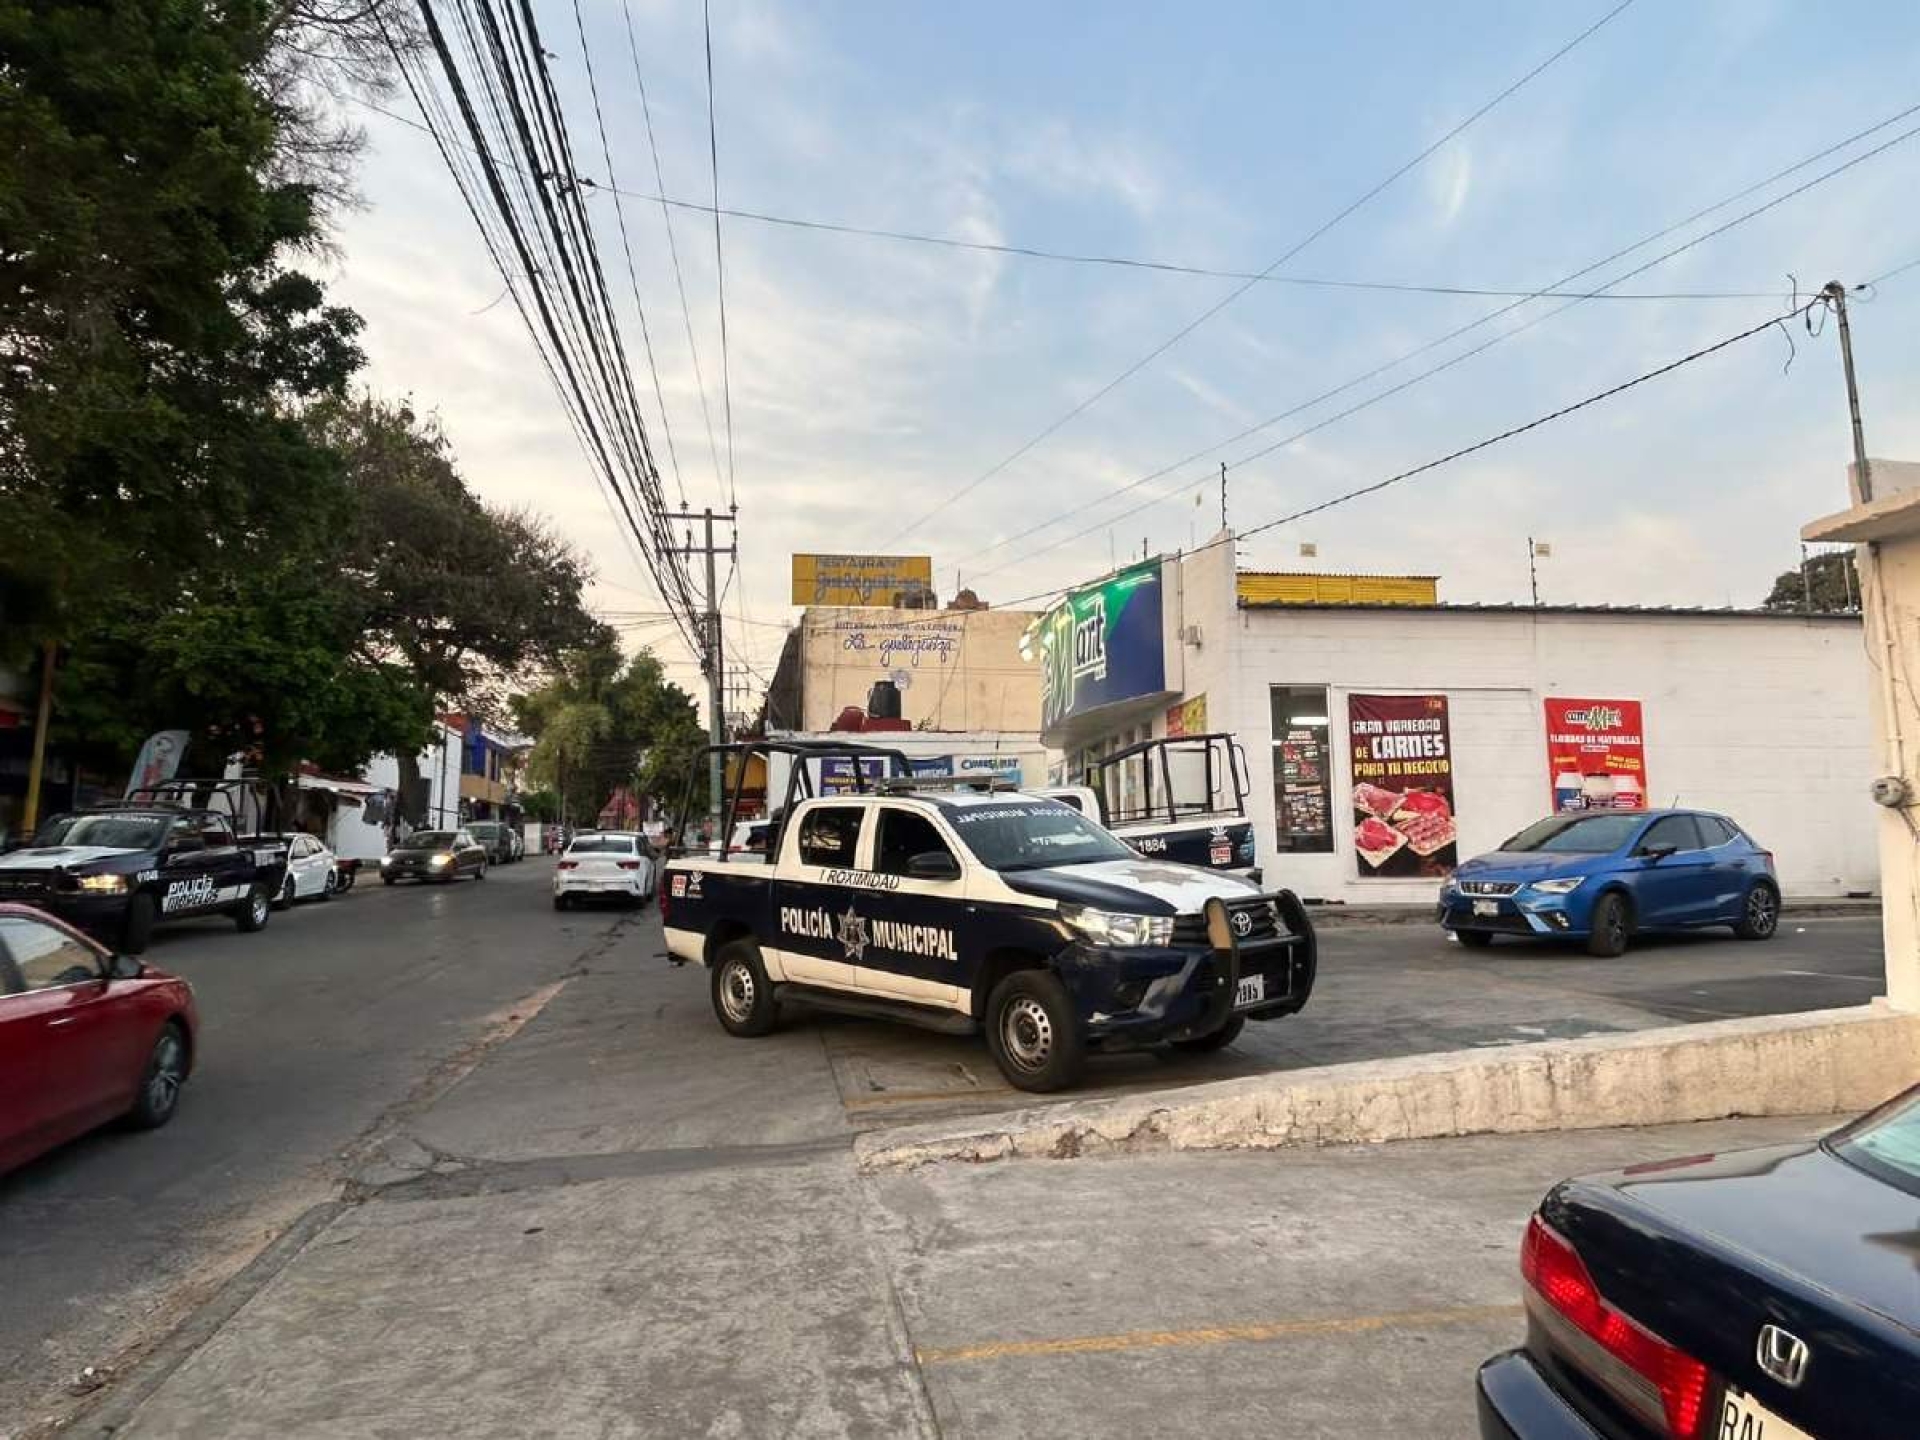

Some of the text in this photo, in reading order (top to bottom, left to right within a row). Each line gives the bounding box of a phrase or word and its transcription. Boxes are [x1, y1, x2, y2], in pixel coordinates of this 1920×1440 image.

[1353, 718, 1441, 734] GRAN VARIEDAD
[1355, 734, 1445, 759] DE CARNES
[1354, 759, 1449, 777] PARA TU NEGOCIO
[780, 906, 958, 961] POLICÍA MUNICIPAL
